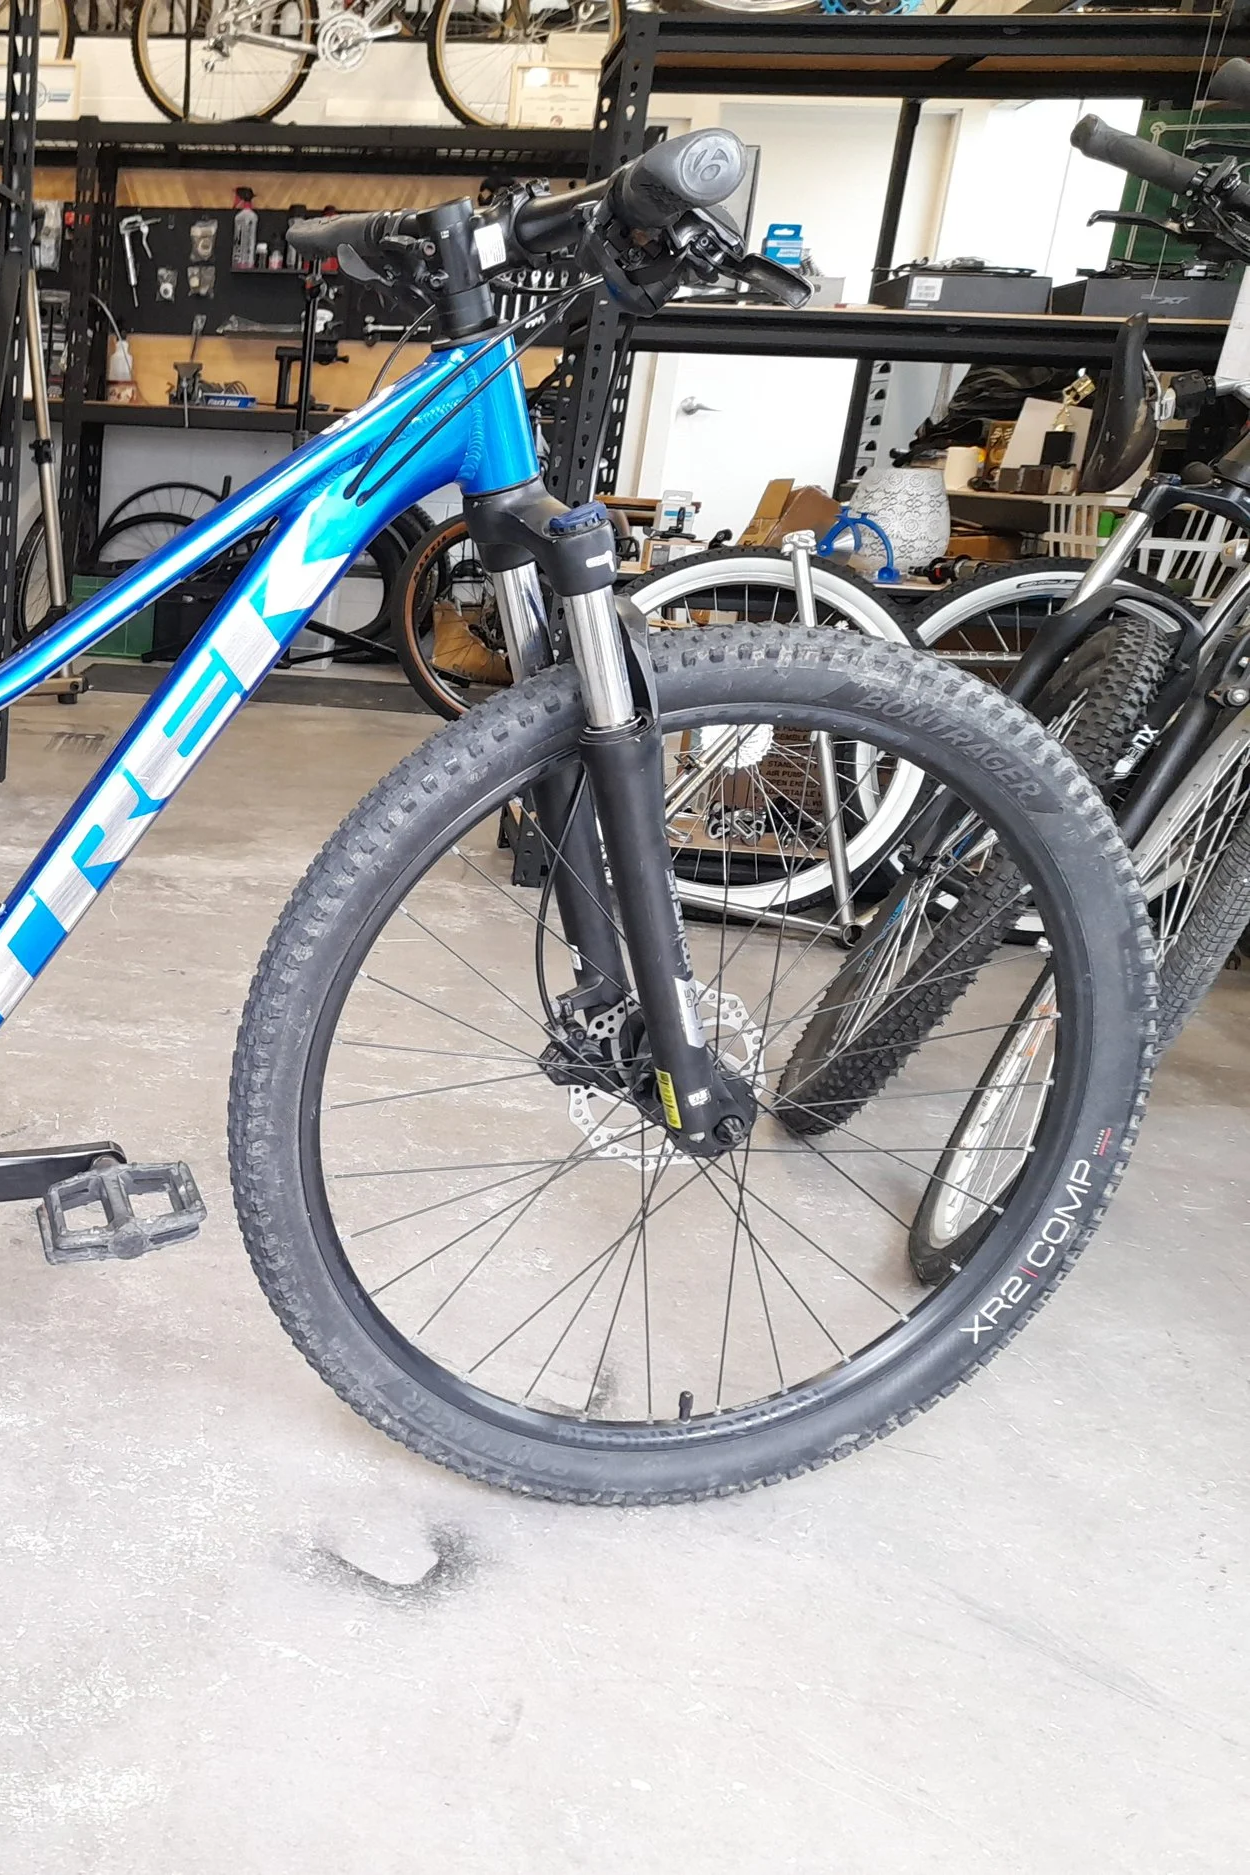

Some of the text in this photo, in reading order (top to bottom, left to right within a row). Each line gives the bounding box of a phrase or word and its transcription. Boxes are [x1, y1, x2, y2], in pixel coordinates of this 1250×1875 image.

[853, 689, 1043, 809] BONTRAGER
[958, 1158, 1093, 1345] XR2 COMP
